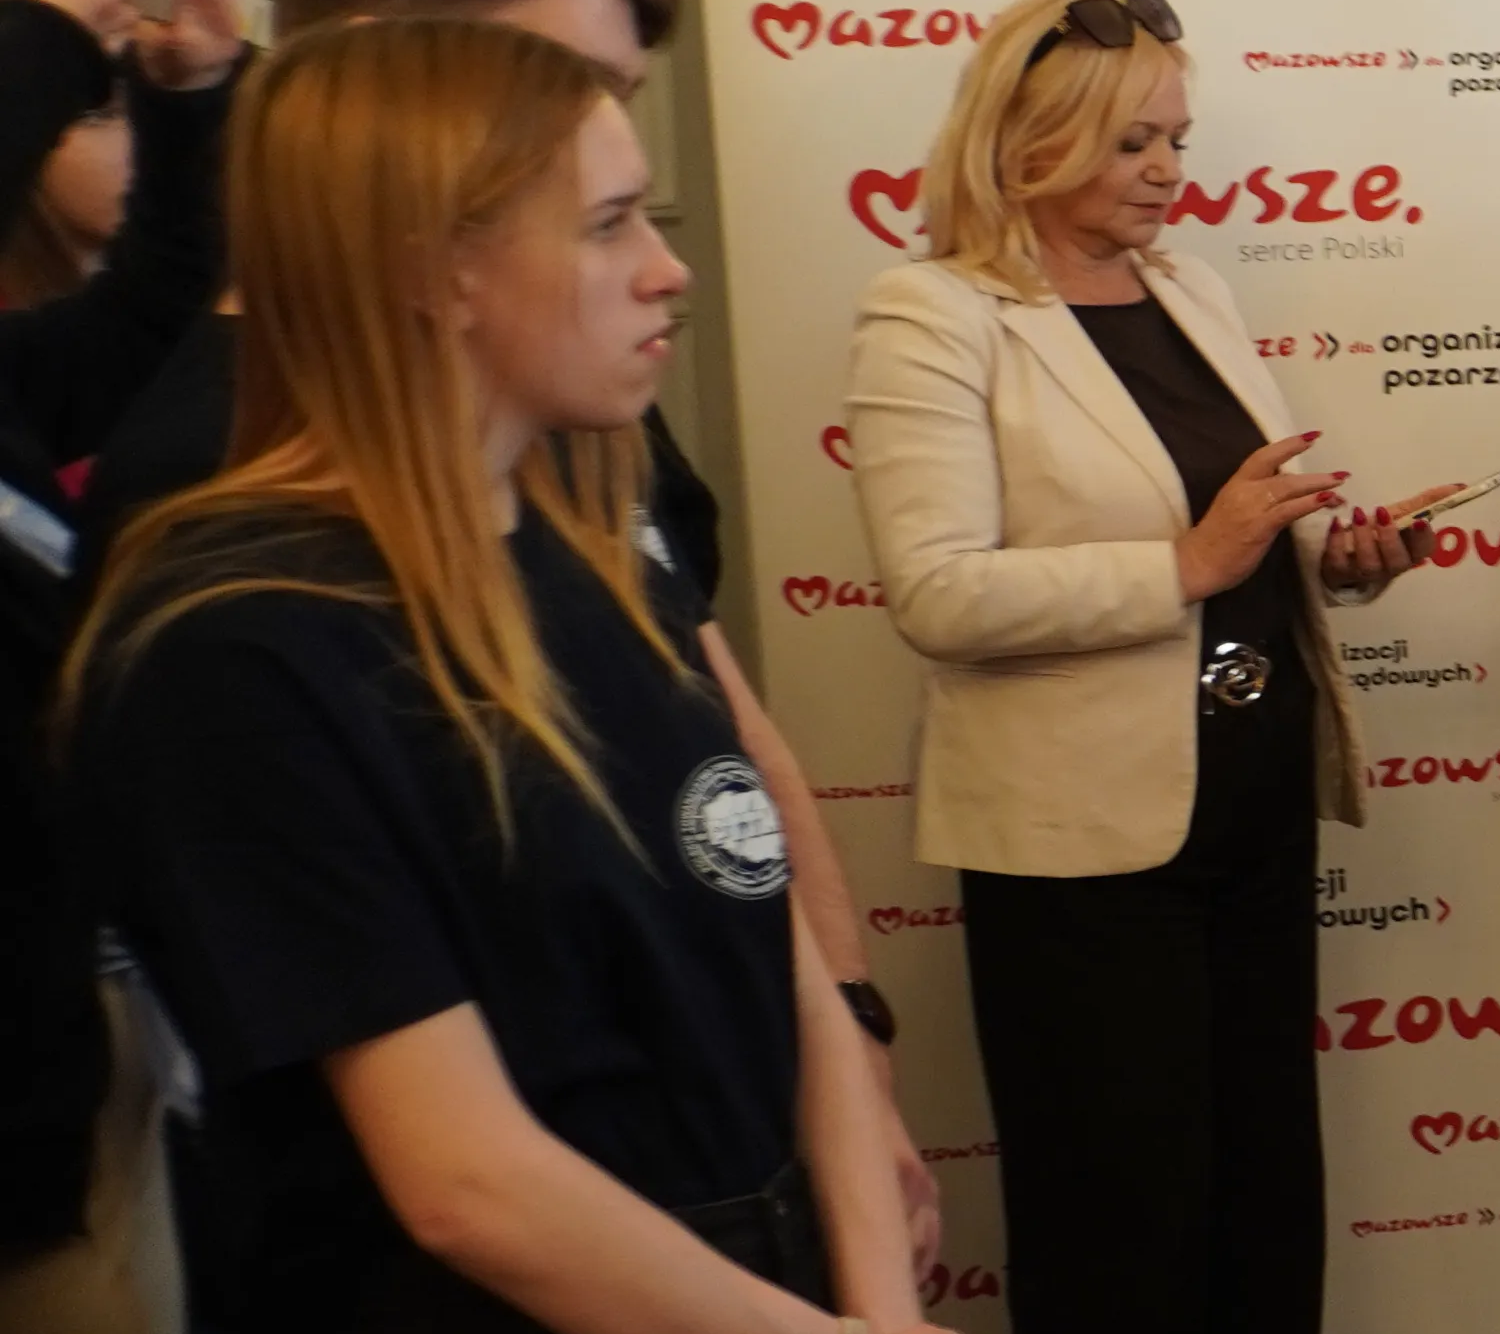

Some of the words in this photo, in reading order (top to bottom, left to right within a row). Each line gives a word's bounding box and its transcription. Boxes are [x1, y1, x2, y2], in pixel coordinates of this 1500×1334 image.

[1237, 237, 1314, 263] serce
[1323, 234, 1405, 260] Polski
[1339, 640, 1408, 664] izacji
